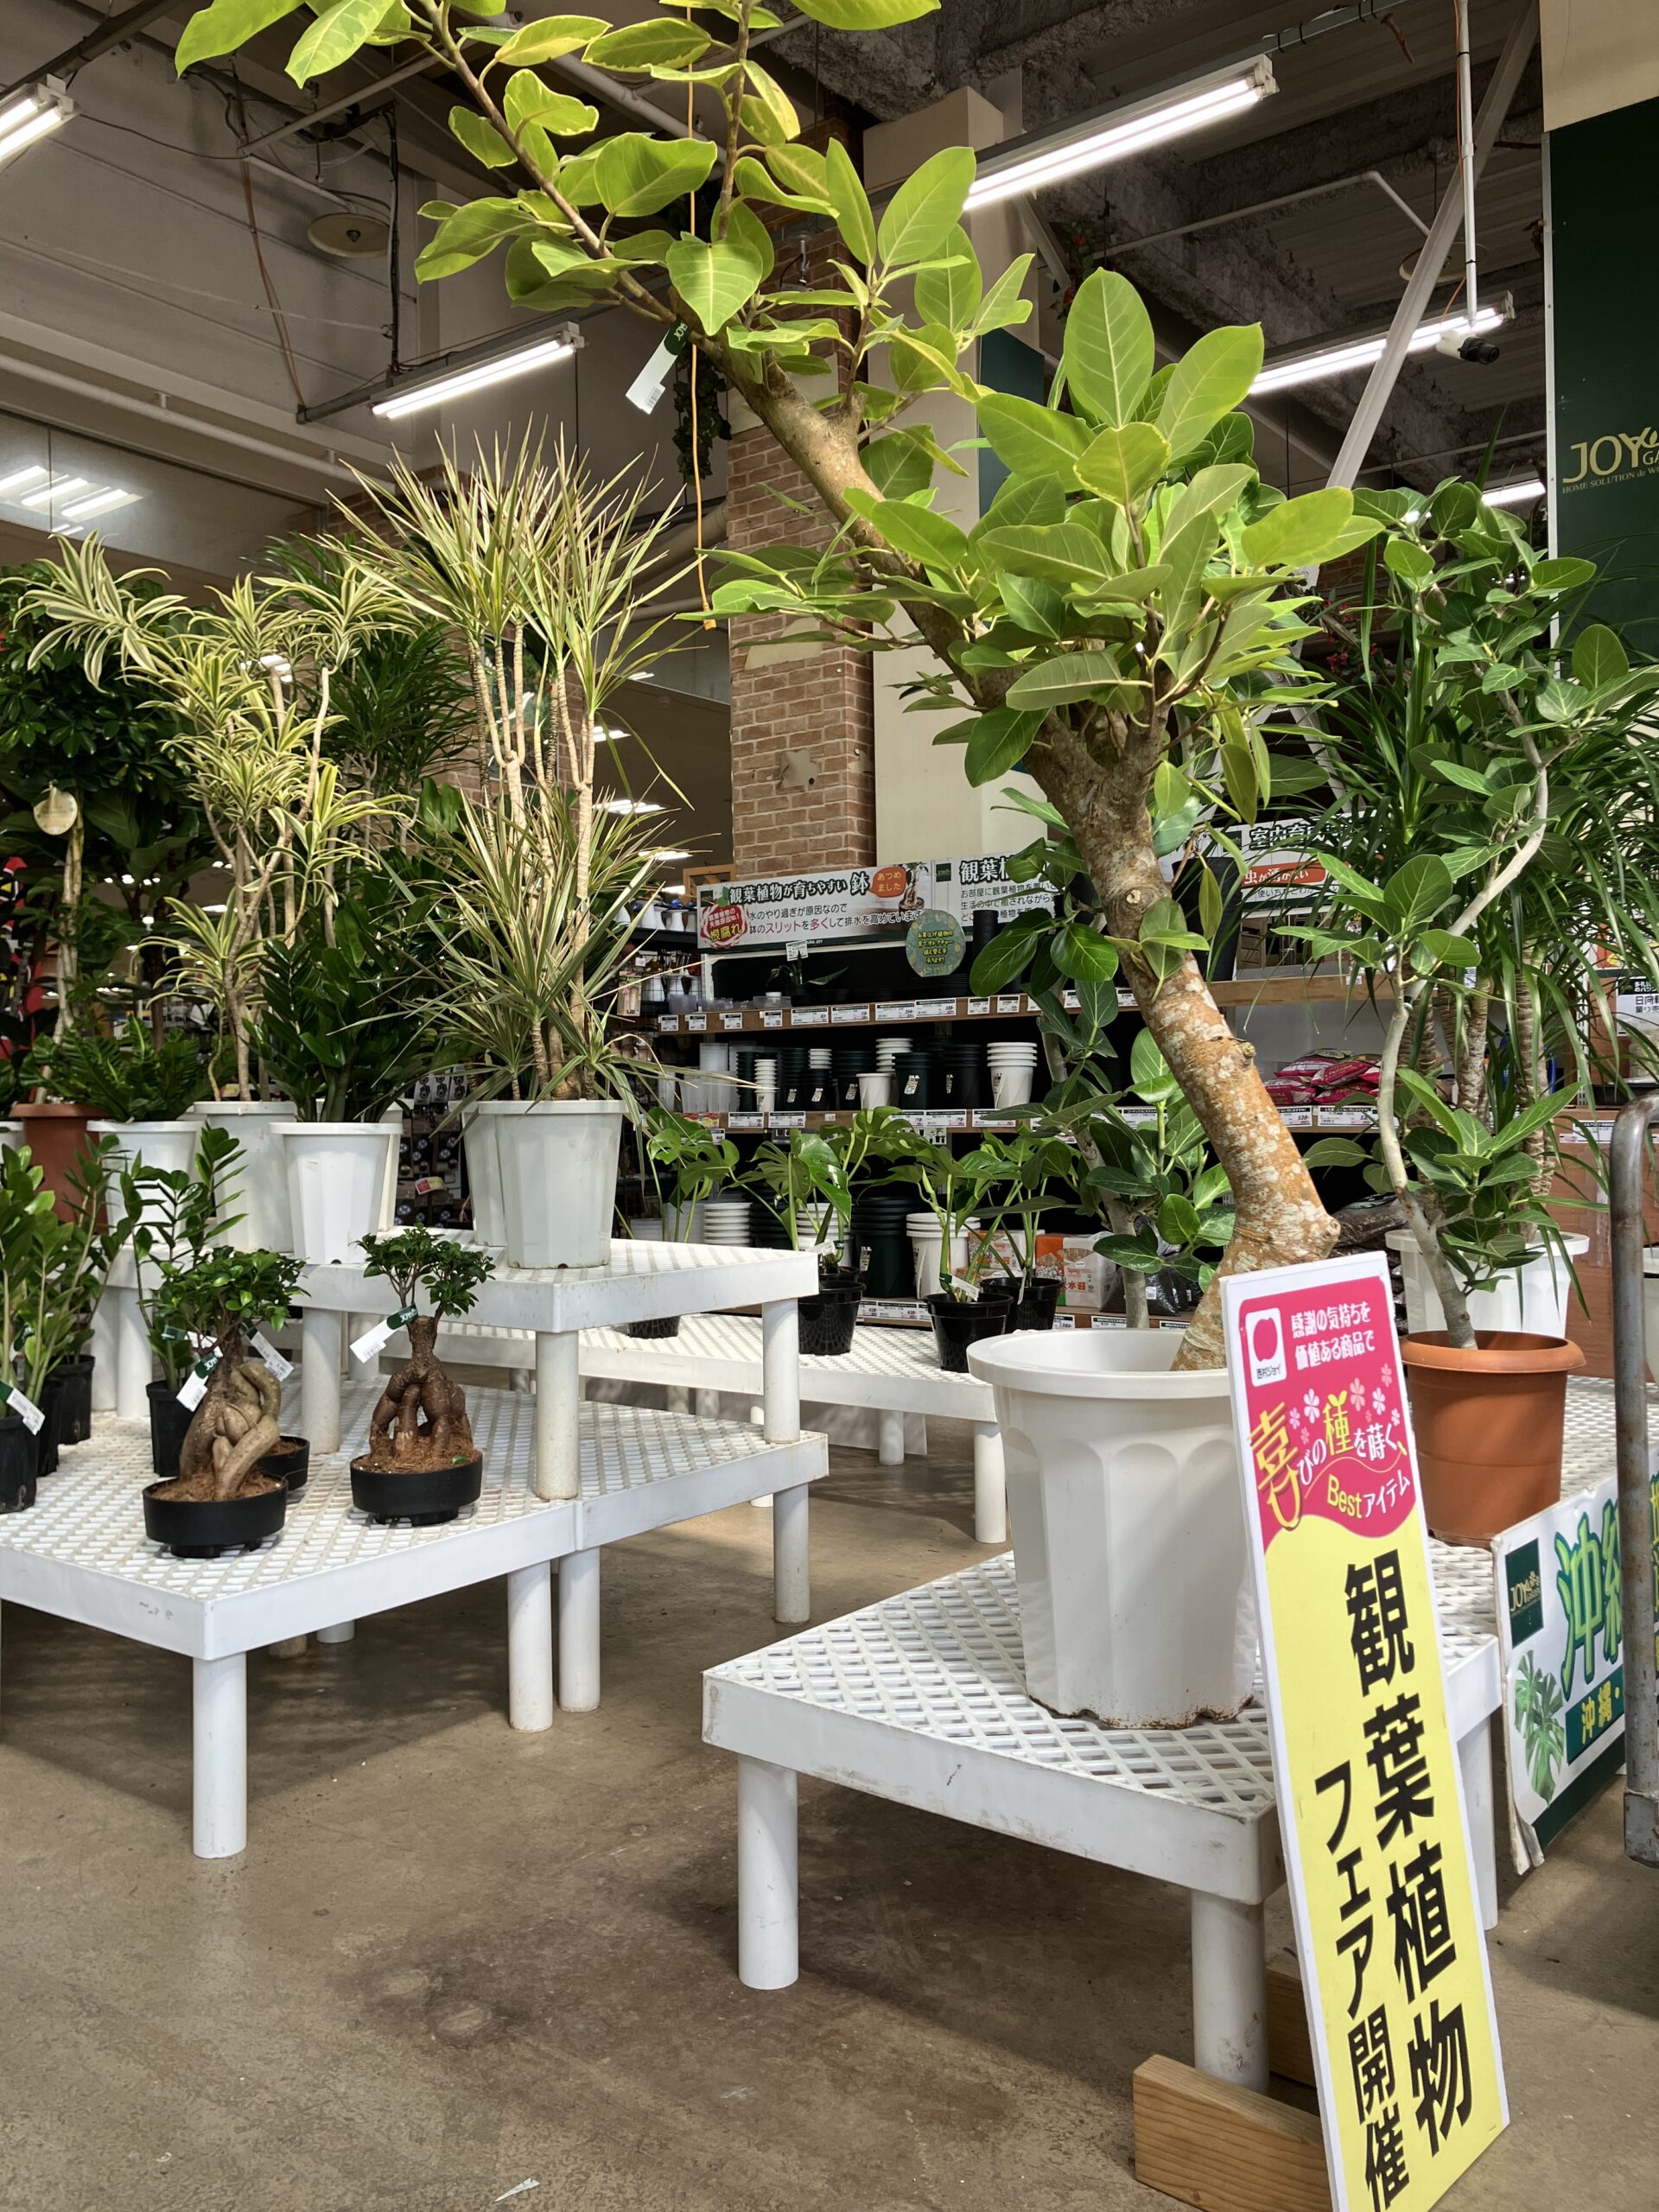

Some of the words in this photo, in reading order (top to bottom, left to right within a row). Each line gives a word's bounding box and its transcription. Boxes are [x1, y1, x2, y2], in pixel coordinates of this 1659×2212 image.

[1562, 482, 1588, 494] HOME
[1590, 472, 1635, 487] SOLUTION
[877, 871, 901, 880] あつめ
[877, 882, 901, 893] ました
[749, 903, 848, 921] 水のやり過ぎが原因なので
[749, 910, 923, 935] 鉢のスリットを多くして排水を高めています
[1291, 1300, 1371, 1338] 感謝の気持ちを
[1295, 1330, 1376, 1370] 価値ある商品で
[1344, 1549, 1472, 2158] 観葉植物
[1314, 1759, 1410, 2212] フェア開催
